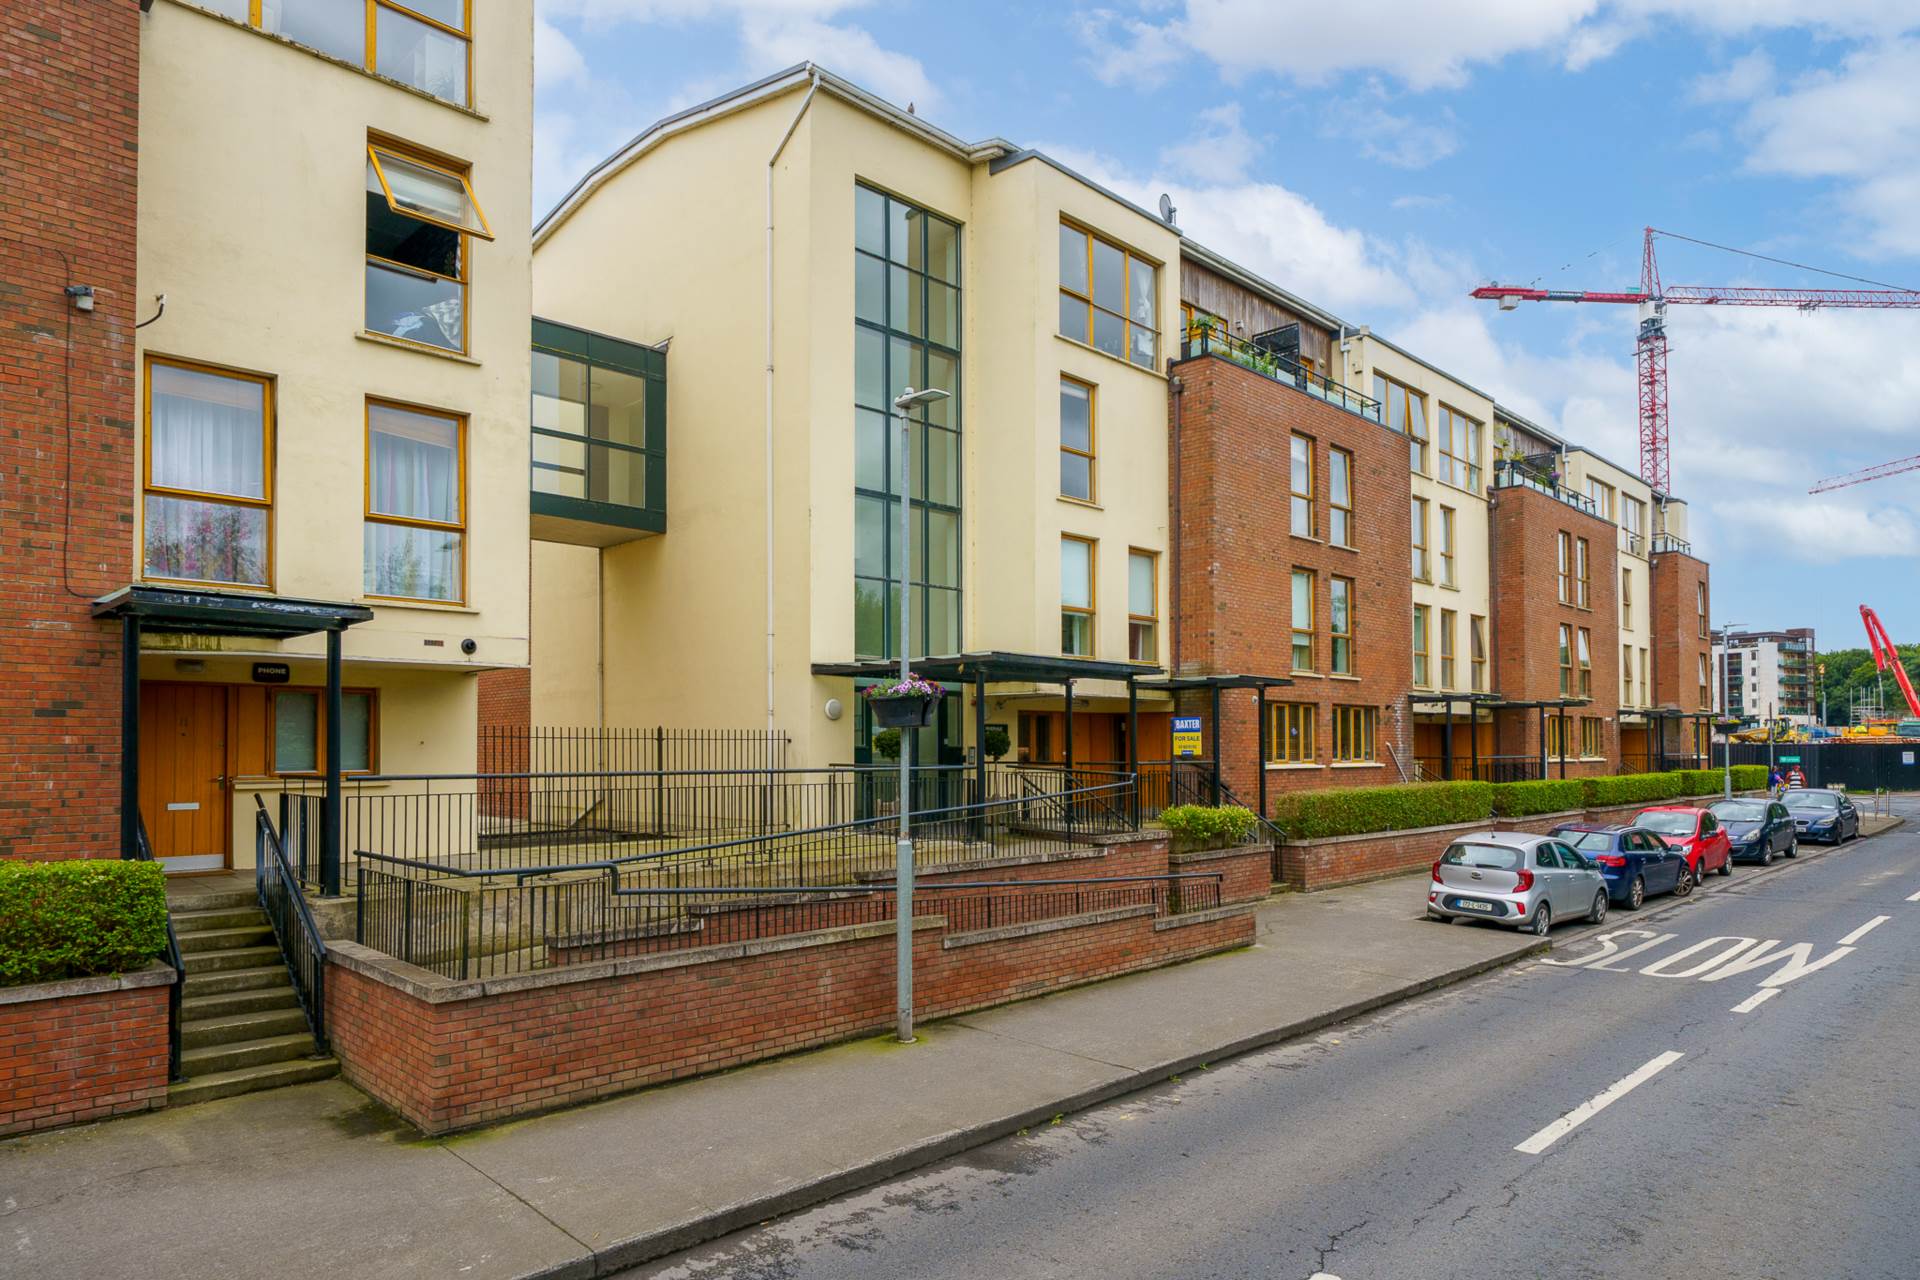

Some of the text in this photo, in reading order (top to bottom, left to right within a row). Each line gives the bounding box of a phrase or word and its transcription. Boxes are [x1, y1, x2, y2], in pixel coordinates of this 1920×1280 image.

[257, 667, 287, 675] PHONE
[1175, 719, 1200, 729] BAXTER
[1540, 930, 1857, 987] SLOW
